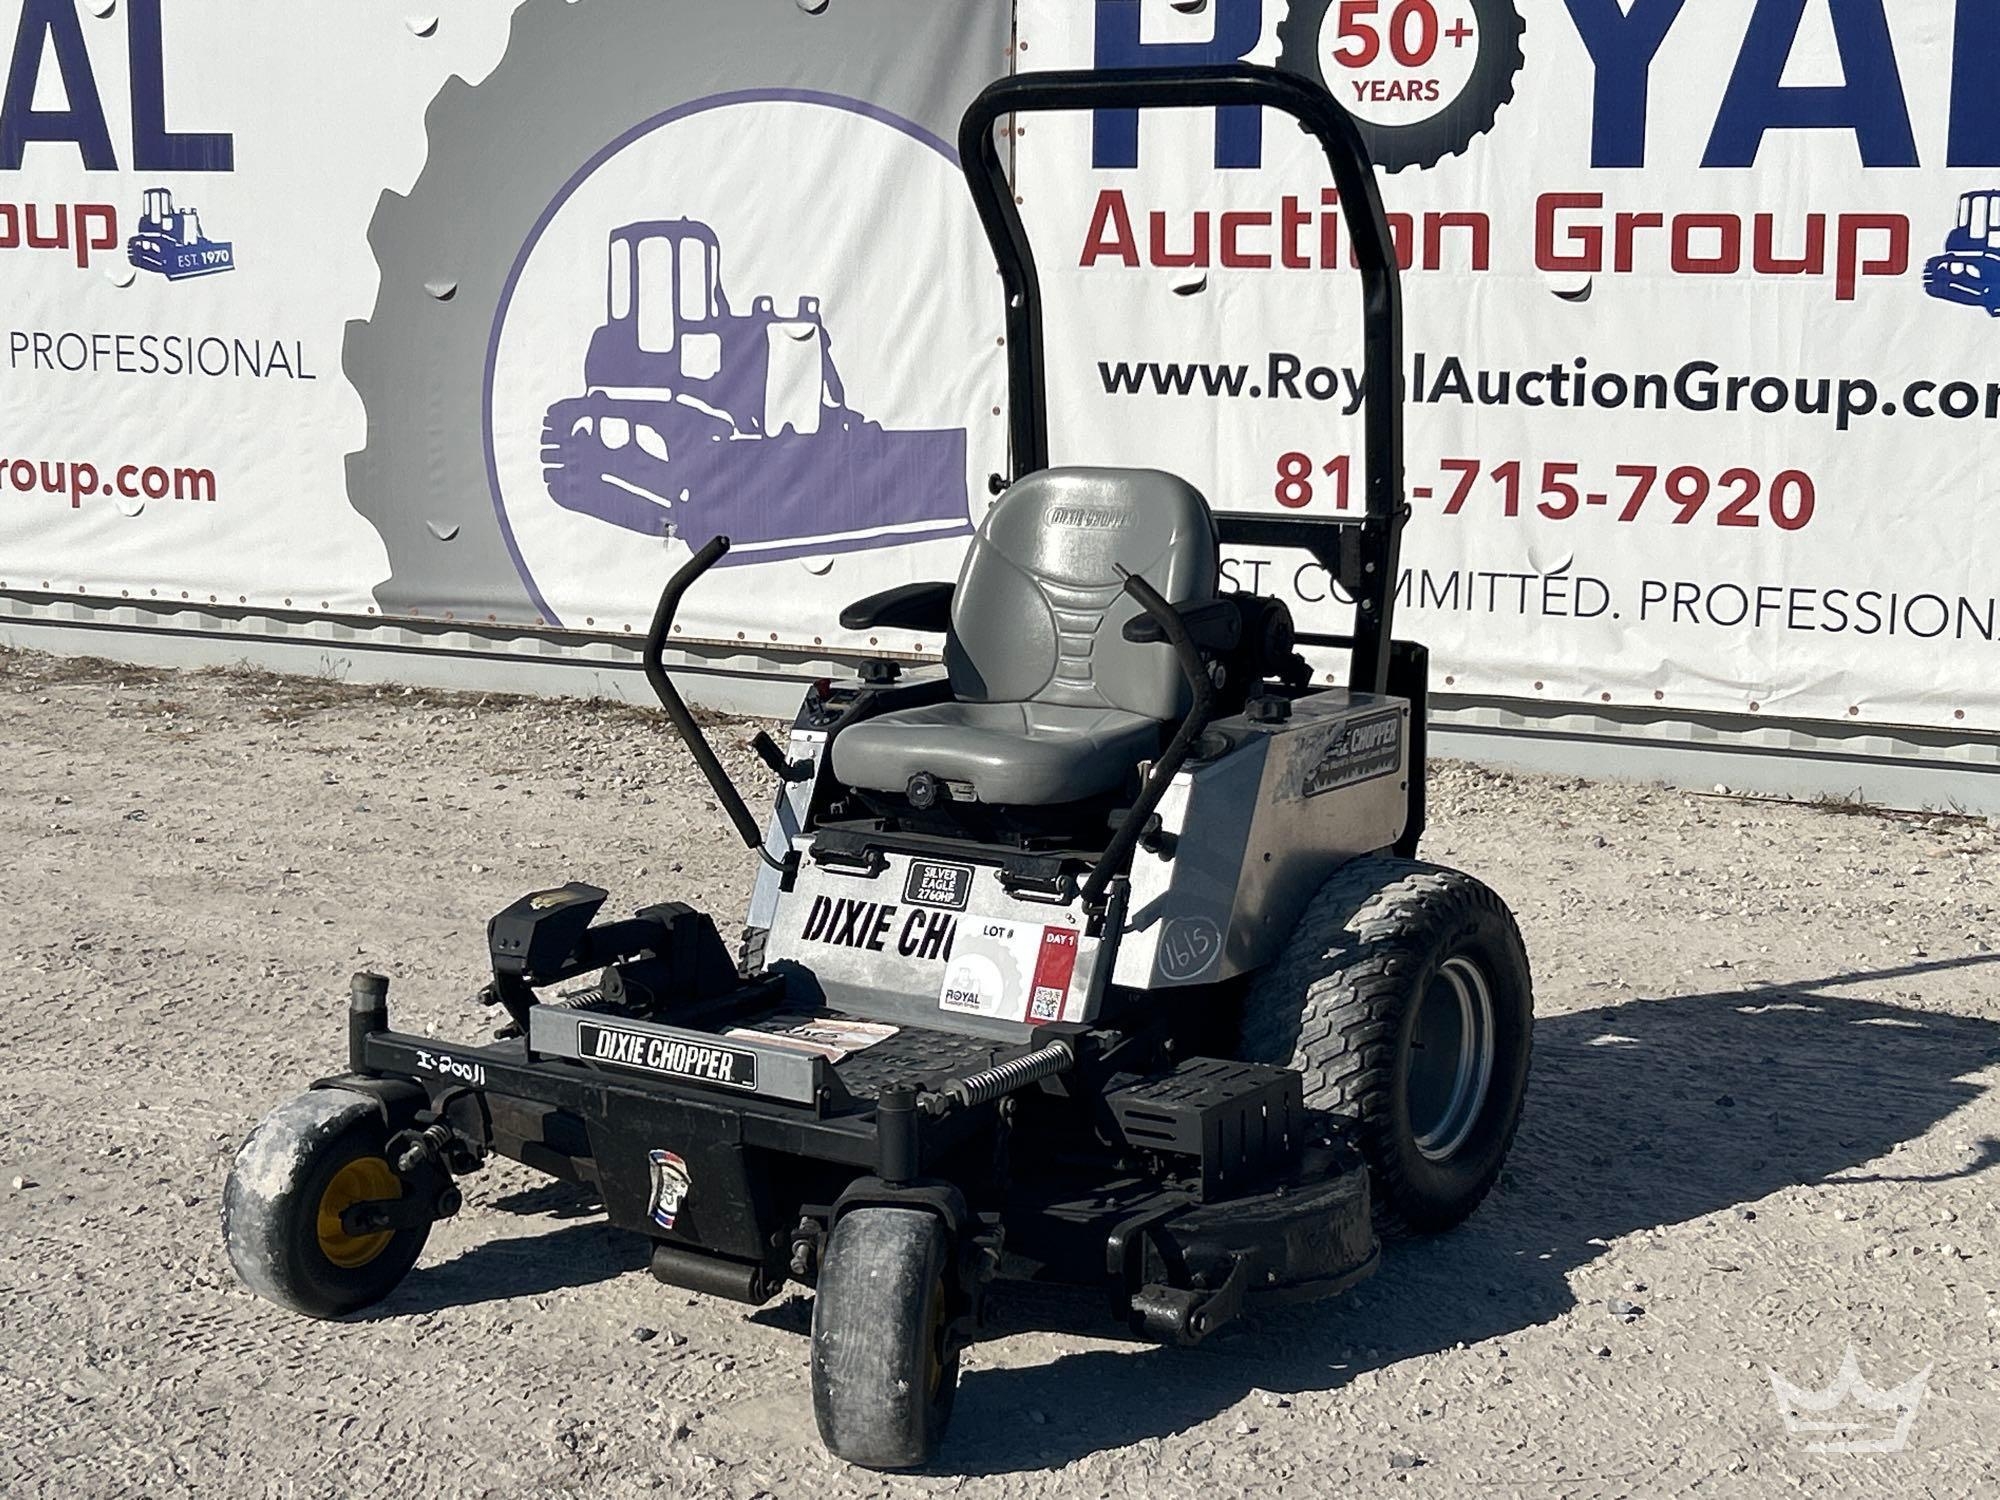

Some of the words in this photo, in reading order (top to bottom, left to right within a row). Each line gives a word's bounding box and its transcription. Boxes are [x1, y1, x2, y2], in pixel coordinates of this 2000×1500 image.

[1332, 0, 1474, 68] 50+
[1351, 79, 1440, 102] YEARS
[178, 253, 199, 268] EST.
[201, 249, 230, 265] 1970
[1535, 191, 1910, 301] Group
[10, 331, 317, 379] PROFESSIONAL
[1097, 352, 2000, 431] www.RoylAuctionGroup.co
[1274, 451, 1816, 531] 81-715-7920
[1640, 580, 2000, 643] PROFESSION
[1351, 718, 1398, 753] CHOPPER
[921, 877, 956, 892] EAGLE
[923, 866, 958, 881] SILVER
[917, 888, 955, 903] 2760HP
[801, 895, 898, 952] DIXIE
[983, 925, 1006, 938] LOT
[1046, 933, 1067, 945] DAY
[1067, 935, 1075, 946] 1
[1165, 927, 1209, 970] 1615
[595, 1029, 647, 1065] DIXIE
[647, 1038, 734, 1082] CHOPPER
